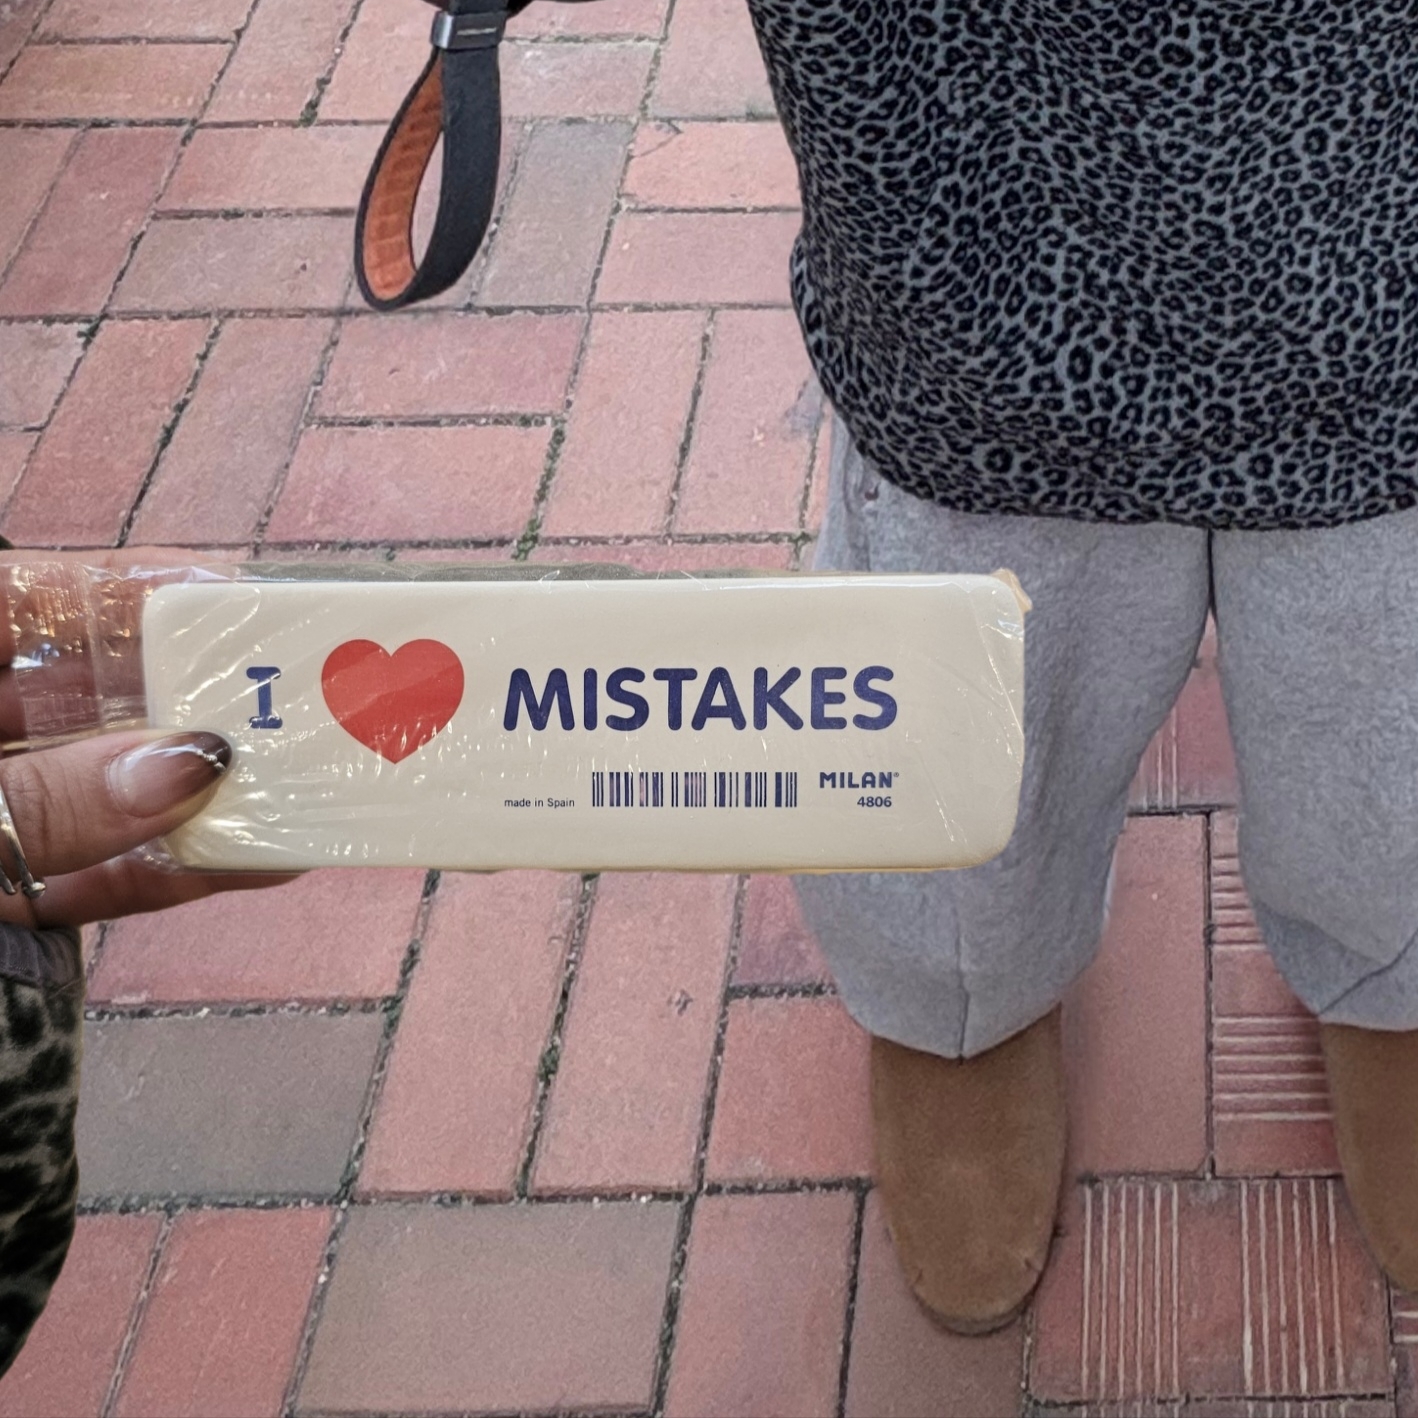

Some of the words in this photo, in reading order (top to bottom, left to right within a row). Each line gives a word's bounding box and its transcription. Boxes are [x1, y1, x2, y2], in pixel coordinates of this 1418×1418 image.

[246, 666, 283, 729] I
[503, 666, 898, 731] MISTAKES
[504, 797, 532, 808] made
[533, 797, 544, 808] in
[547, 797, 575, 809] Spain
[857, 796, 893, 808] 4806
